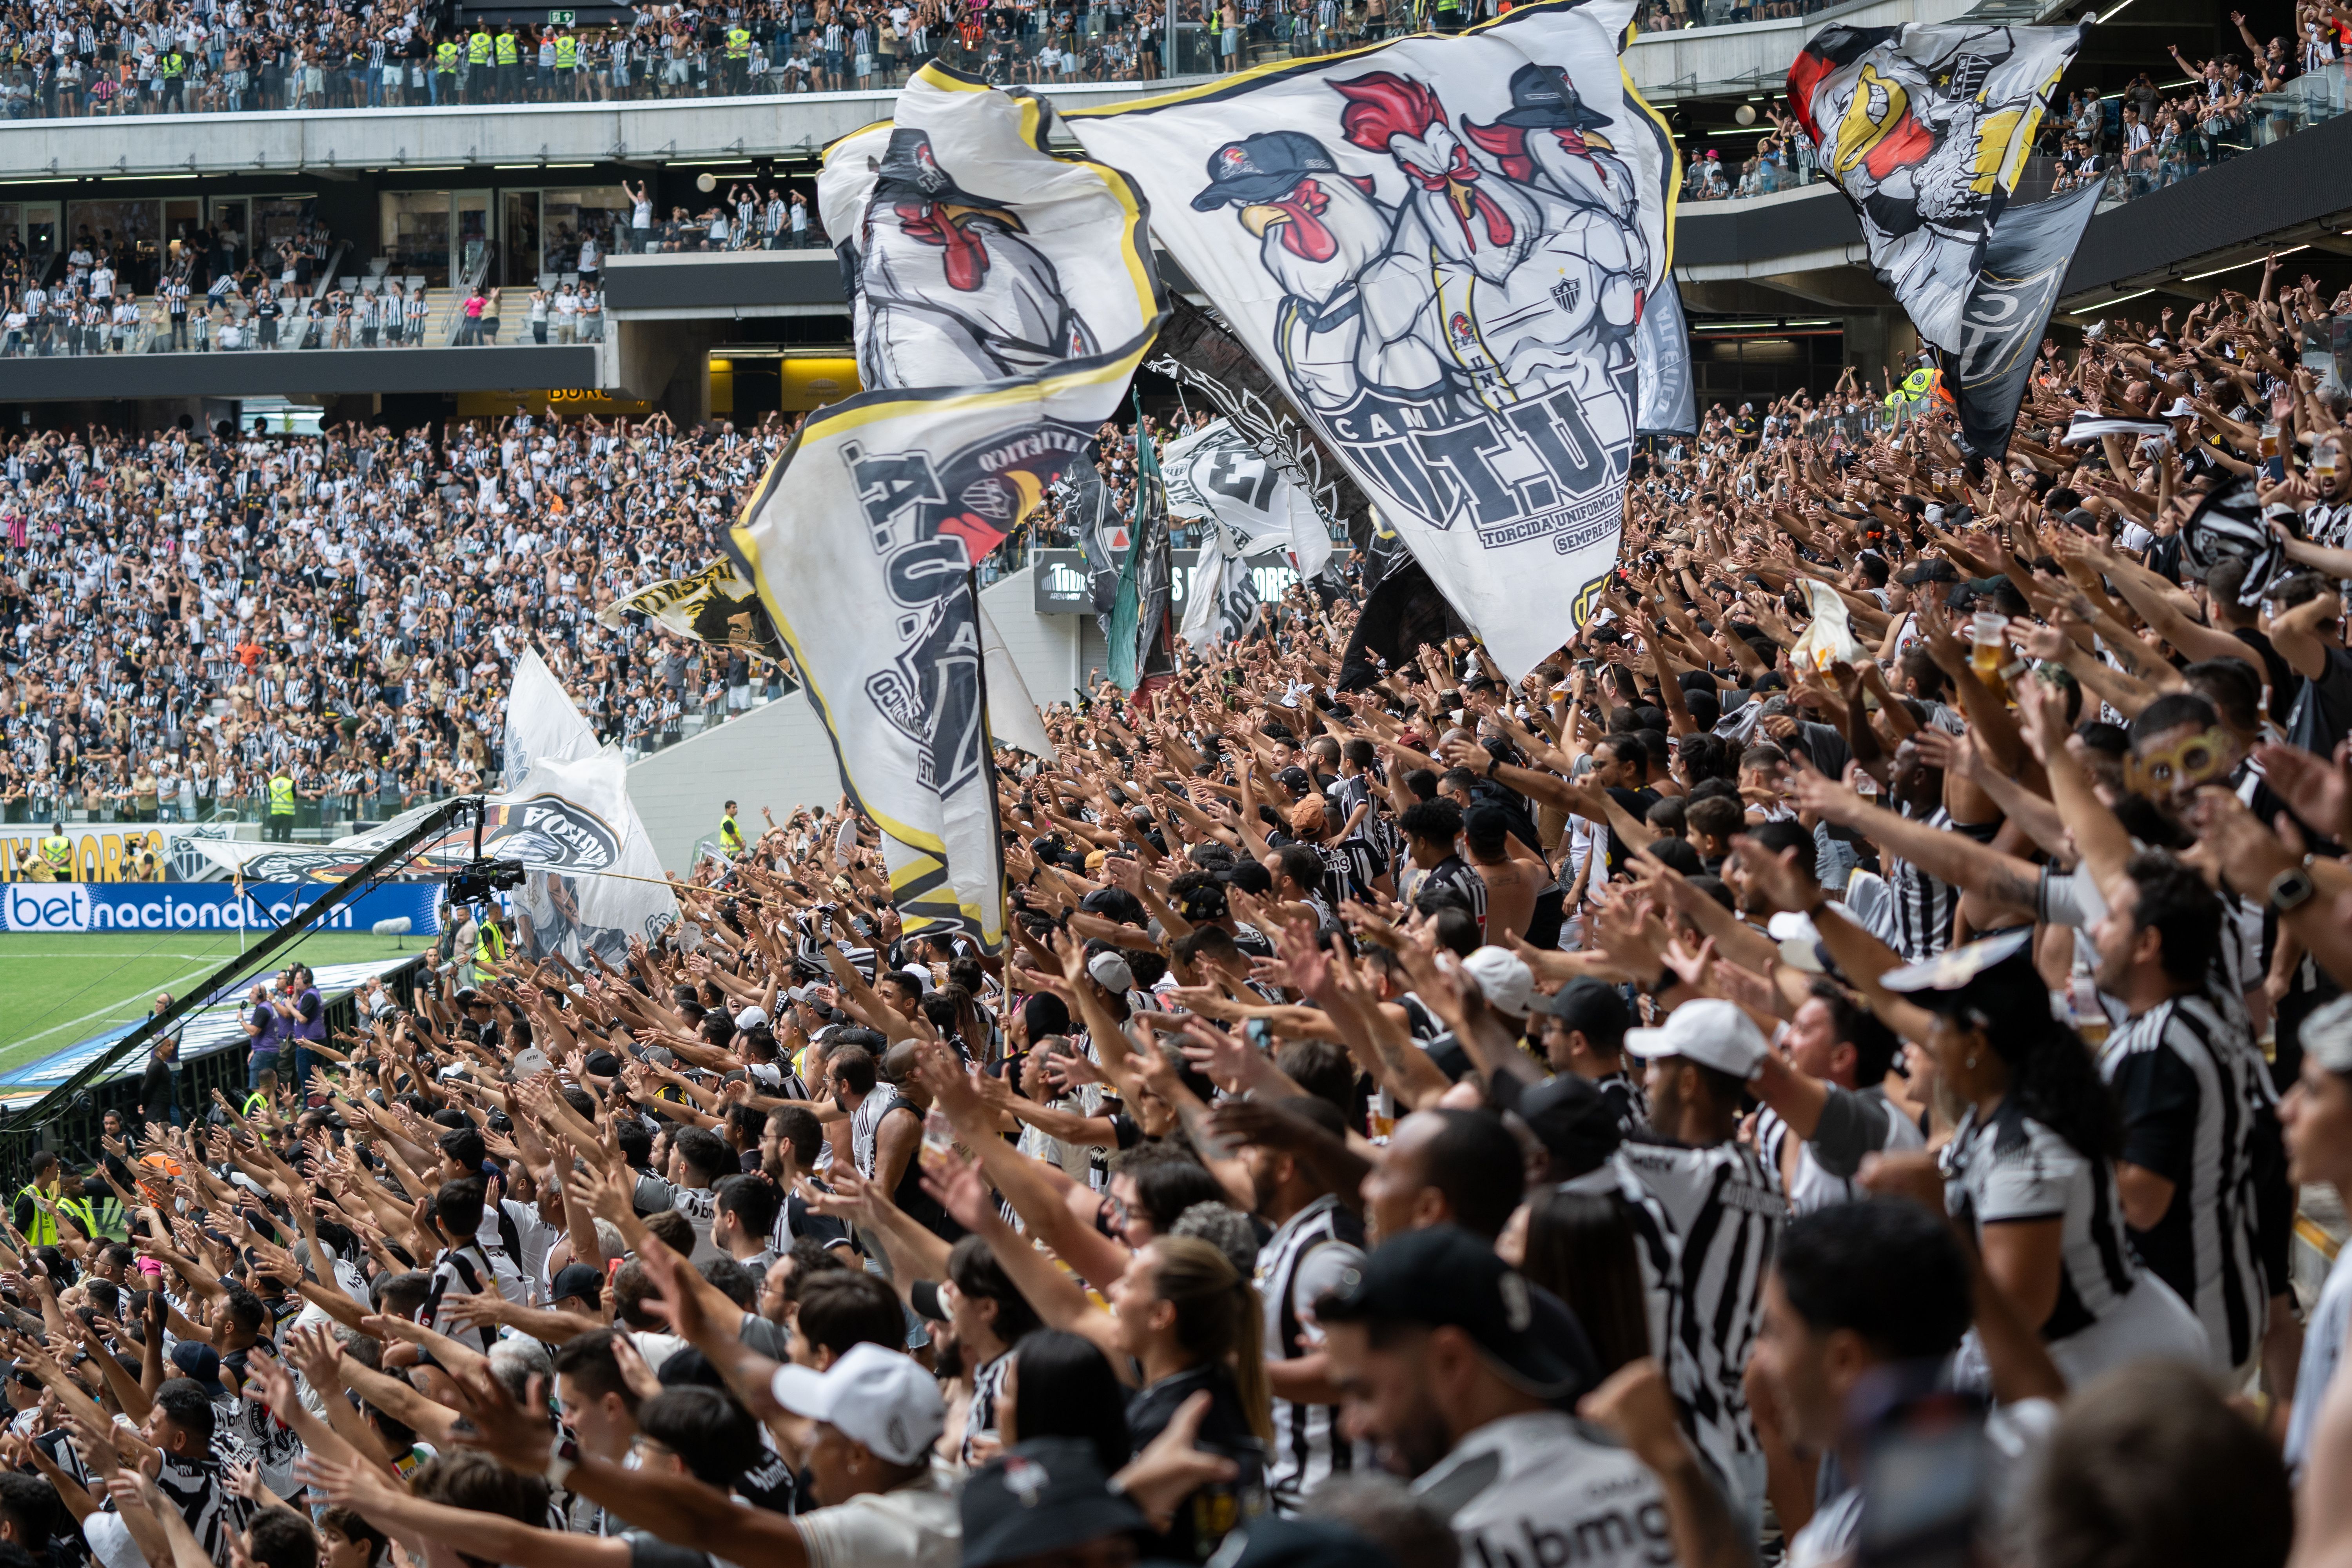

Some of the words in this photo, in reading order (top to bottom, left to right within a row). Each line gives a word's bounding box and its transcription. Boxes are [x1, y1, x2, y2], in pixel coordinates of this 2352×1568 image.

[1555, 283, 1577, 295] CAM
[1335, 408, 1428, 439] CAM
[1484, 518, 1553, 544] TORCIDA
[1555, 488, 1624, 527] UNIFORMIZAD
[1557, 523, 1603, 551] SEMPRE
[1604, 514, 1622, 534] PRES
[13, 887, 83, 927] bet
